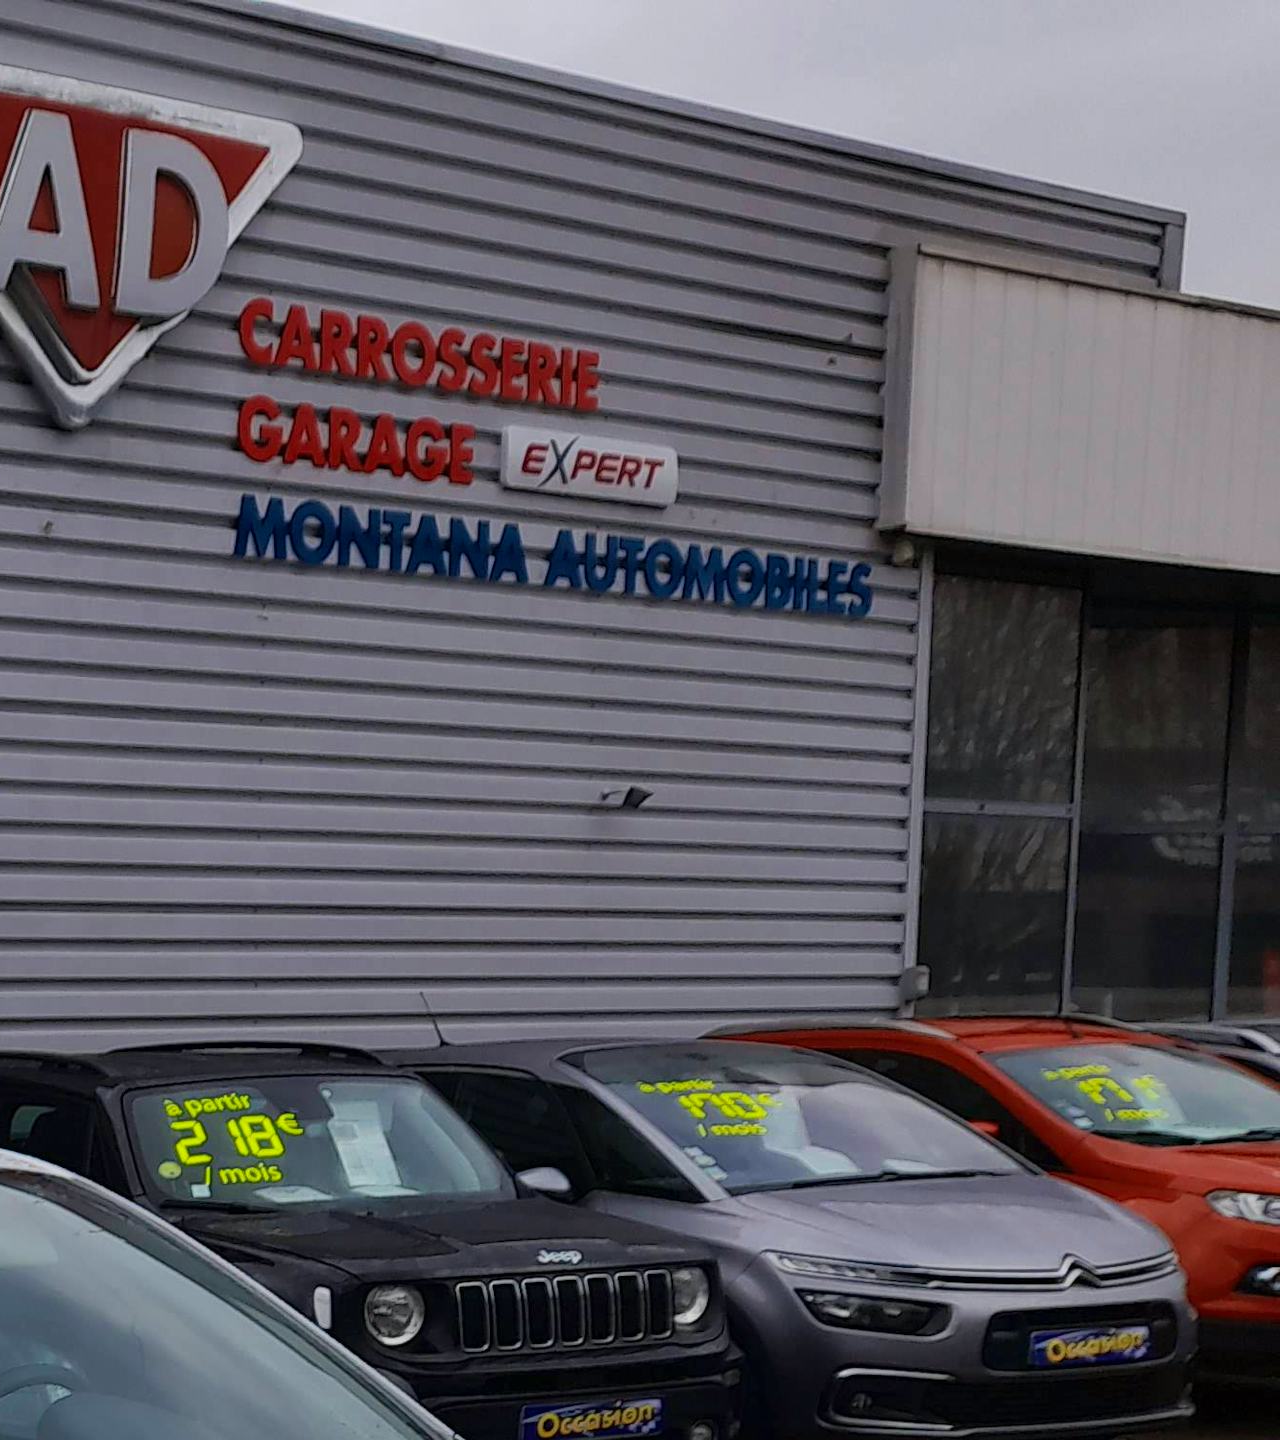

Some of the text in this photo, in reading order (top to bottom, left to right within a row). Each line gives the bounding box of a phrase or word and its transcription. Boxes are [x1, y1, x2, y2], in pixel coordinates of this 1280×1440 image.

[238, 297, 601, 412] CARROSSERIE
[237, 394, 476, 486] GARAGE
[233, 493, 874, 620] MONTANA AUTOMOBILES
[183, 1092, 251, 1118] partir
[217, 1162, 284, 1185] mois
[1046, 1327, 1143, 1364] Occasion
[537, 1400, 653, 1439] Occasion
